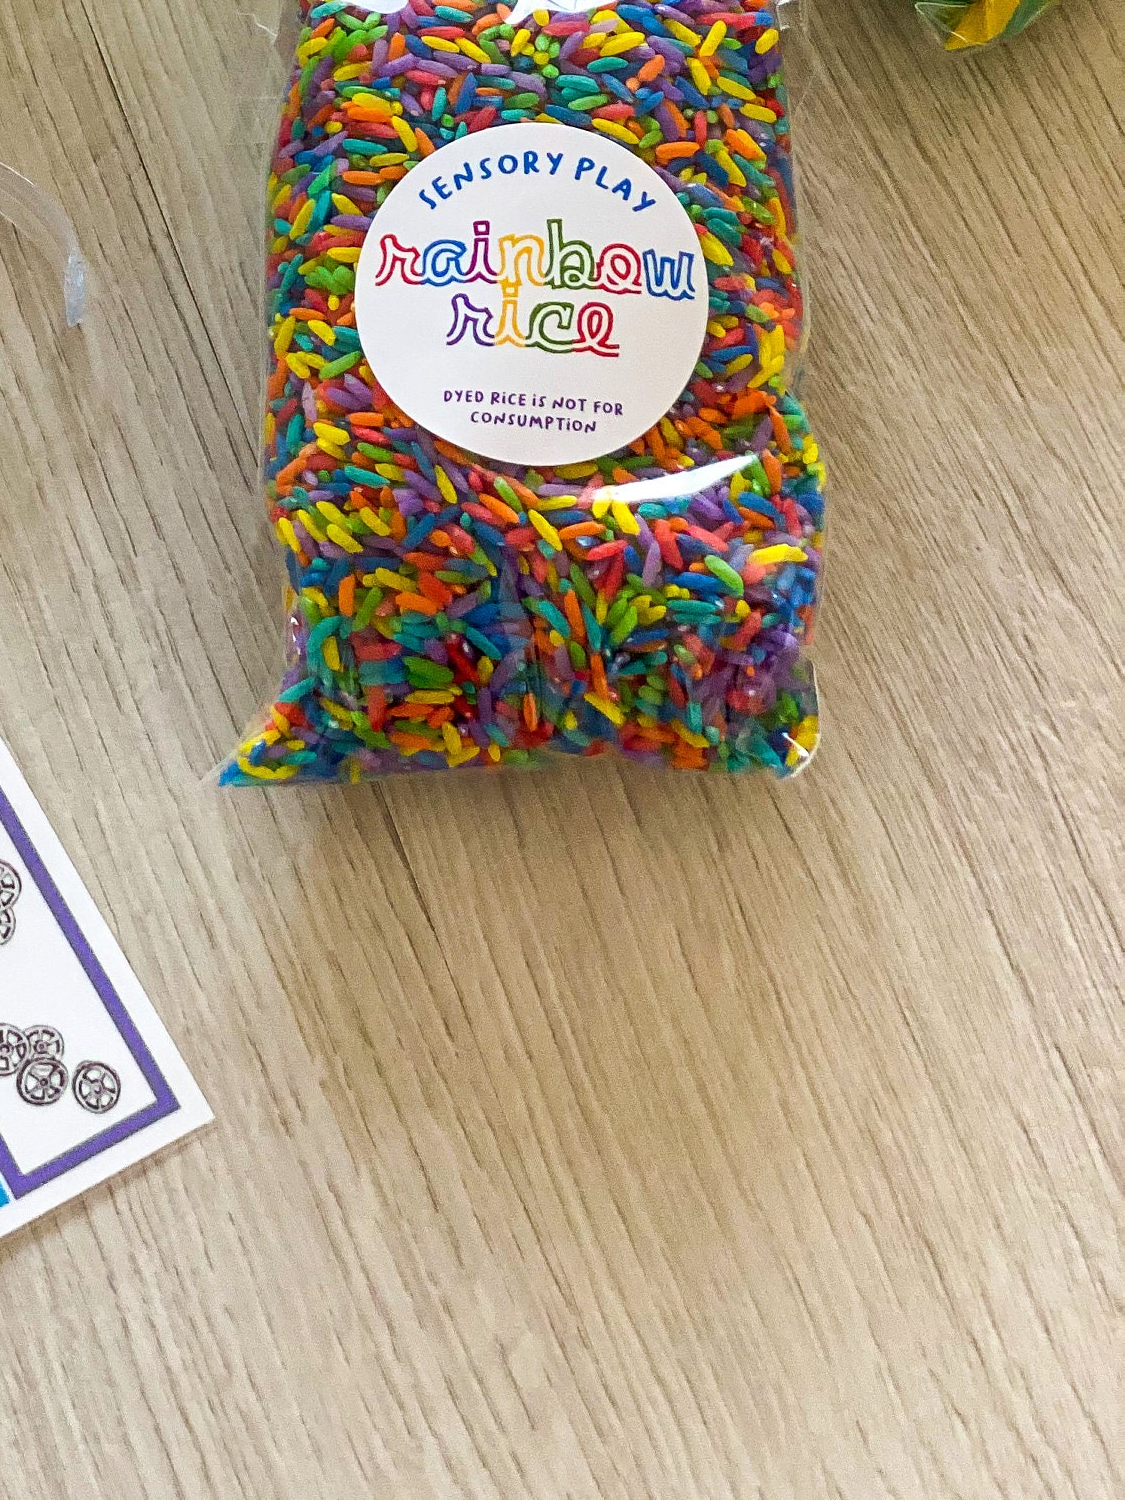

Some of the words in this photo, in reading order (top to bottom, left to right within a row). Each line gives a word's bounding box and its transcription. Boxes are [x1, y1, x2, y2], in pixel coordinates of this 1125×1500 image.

[418, 150, 564, 211] SENSORY
[574, 157, 656, 212] PLAY
[375, 218, 695, 301] rainbow
[446, 282, 619, 357] rice
[444, 389, 484, 404] DYED
[551, 396, 587, 412] NOT
[593, 400, 624, 417] FOR
